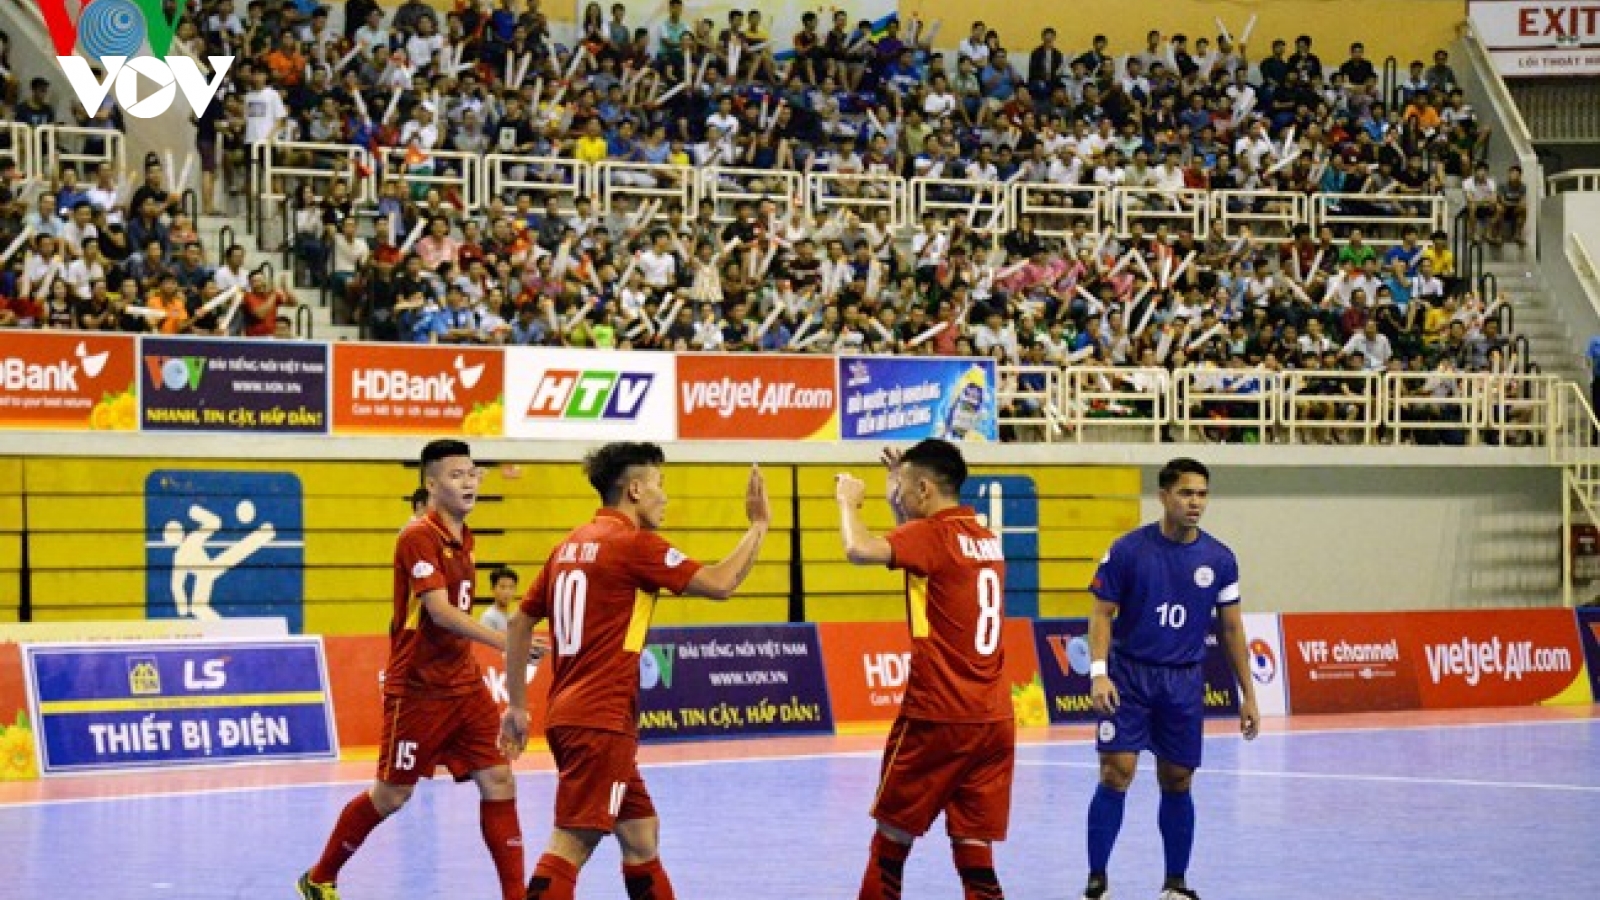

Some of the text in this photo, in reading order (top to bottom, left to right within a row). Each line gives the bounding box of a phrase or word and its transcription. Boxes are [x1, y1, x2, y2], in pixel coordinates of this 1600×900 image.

[1519, 6, 1600, 37] EXIT
[145, 355, 207, 391] VOV
[351, 368, 456, 403] HDBank
[527, 369, 656, 419] HTV
[553, 569, 588, 656] 10
[975, 567, 1000, 656] 8
[1155, 602, 1187, 629] 10
[639, 643, 675, 689] OV
[1297, 637, 1399, 663] VFF channel
[184, 658, 228, 690] LS
[88, 711, 289, 755] THIẾT BỊ ĐIỆN
[638, 709, 678, 730] ANH,
[679, 707, 707, 726] TIN
[395, 740, 419, 771] 15
